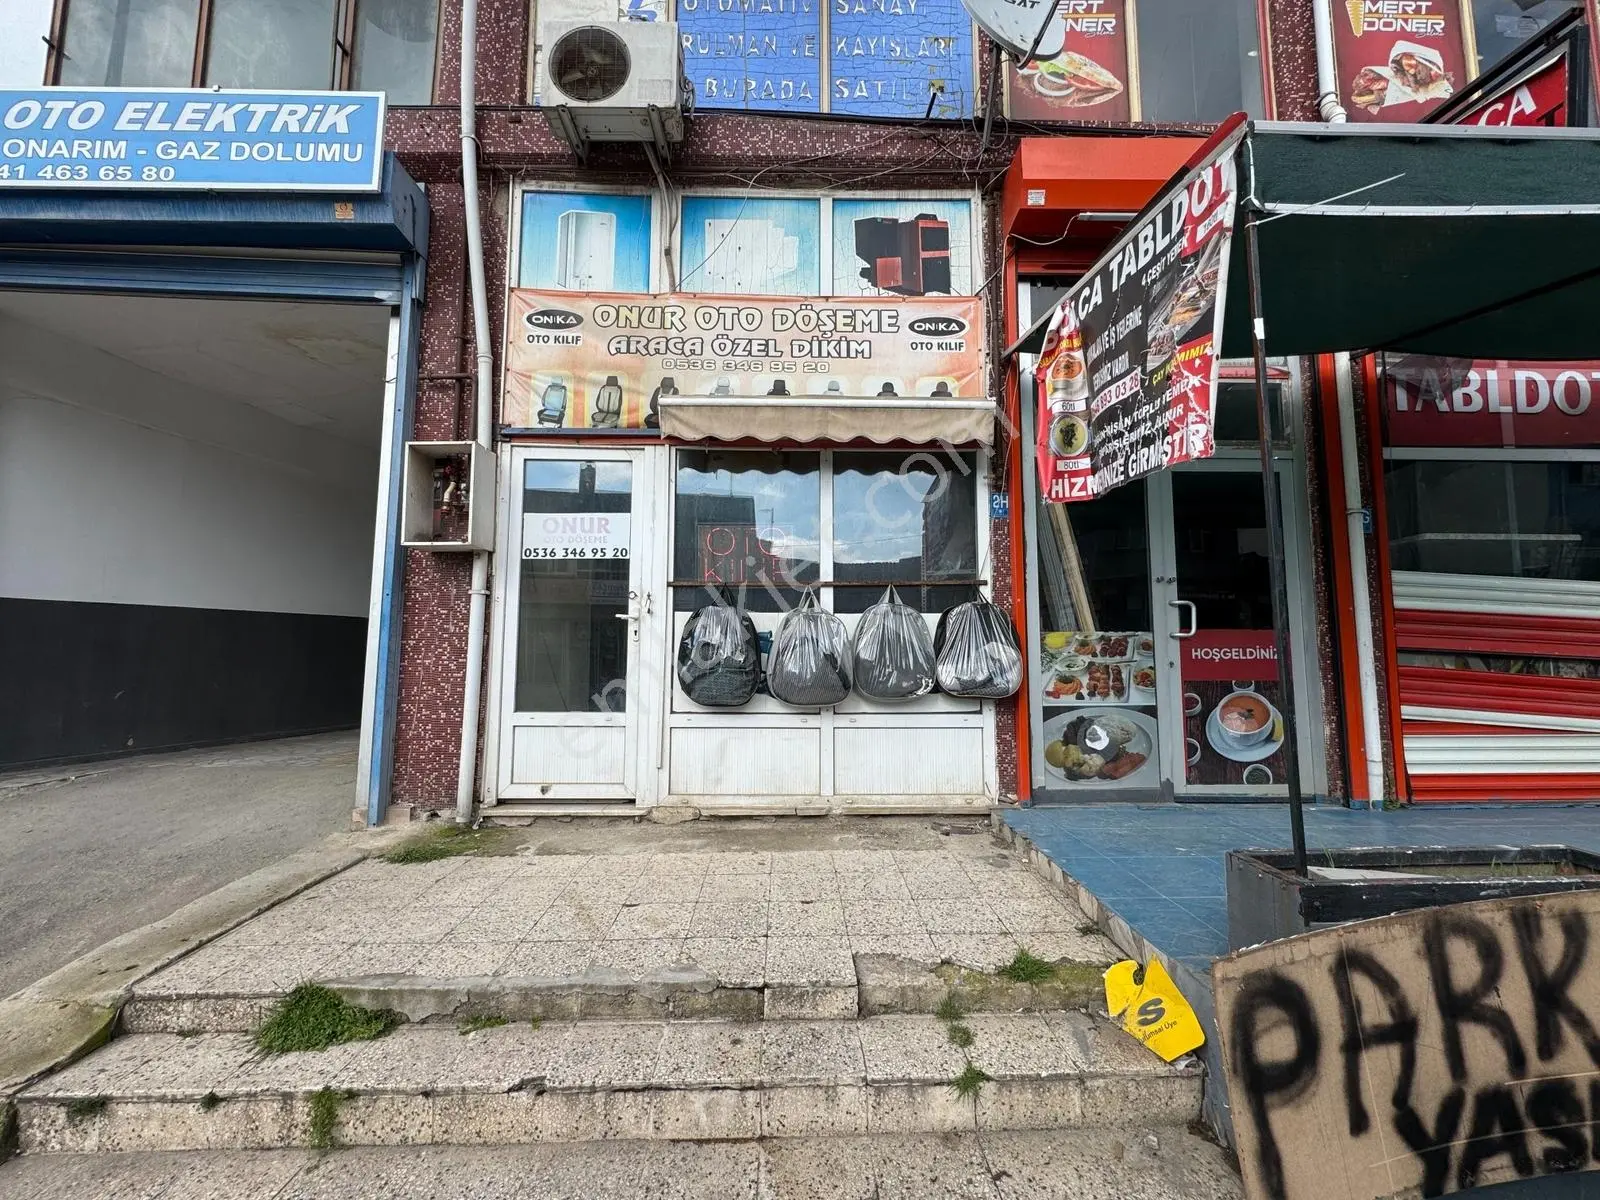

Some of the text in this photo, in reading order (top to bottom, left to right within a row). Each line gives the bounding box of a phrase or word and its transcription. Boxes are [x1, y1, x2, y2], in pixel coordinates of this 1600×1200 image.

[1056, 0, 1105, 13] ERT
[1364, 0, 1433, 14] MERT
[1066, 18, 1117, 32] NER
[1363, 16, 1446, 33] DÖNER
[705, 78, 814, 100] BURADA
[3, 99, 106, 131] OTO
[2, 138, 127, 159] ONARIM
[156, 140, 221, 161] GAZ
[229, 142, 363, 163] DOLUMU
[37, 164, 89, 181] 463
[98, 165, 132, 181] 65
[141, 166, 176, 182] 80
[1109, 147, 1235, 293] TABLDOT
[593, 304, 900, 339] ONUR OTO DÖŞEME
[527, 334, 582, 346] OTO KILIF
[607, 333, 872, 359] ARACA ÖZEL DİKİM
[910, 341, 965, 352] OTO KILIF
[662, 358, 830, 374] 0536 346 95 20
[1115, 381, 1127, 399] 03
[1129, 372, 1139, 391] 28
[993, 494, 1009, 509] 2H
[542, 516, 611, 534] ONUR
[544, 533, 608, 545] OTO DÖŞEME
[524, 547, 629, 558] 0536 346 95 20
[1137, 997, 1166, 1027] S
[1230, 903, 1600, 1200] PARK
[1394, 1080, 1600, 1200] YAS
